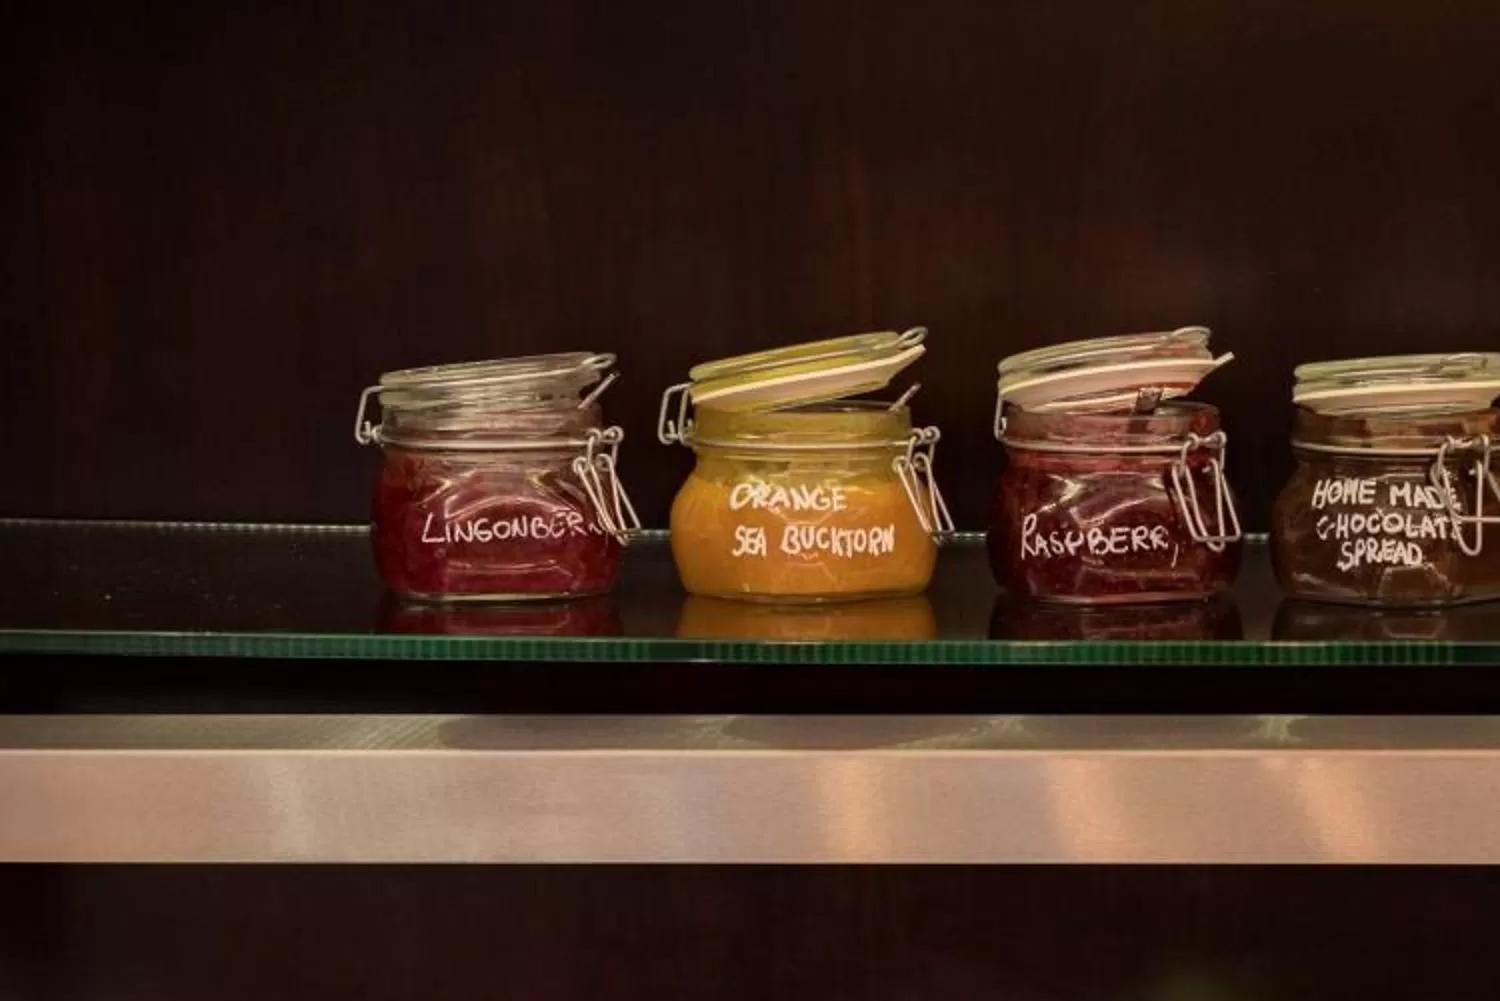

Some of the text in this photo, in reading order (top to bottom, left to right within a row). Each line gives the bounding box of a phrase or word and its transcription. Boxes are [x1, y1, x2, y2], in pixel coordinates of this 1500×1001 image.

[729, 483, 848, 511] ORANGE
[1312, 478, 1377, 509] HOME
[732, 524, 895, 558] SEA BUCKTORN
[1337, 537, 1423, 571] SPREAD
